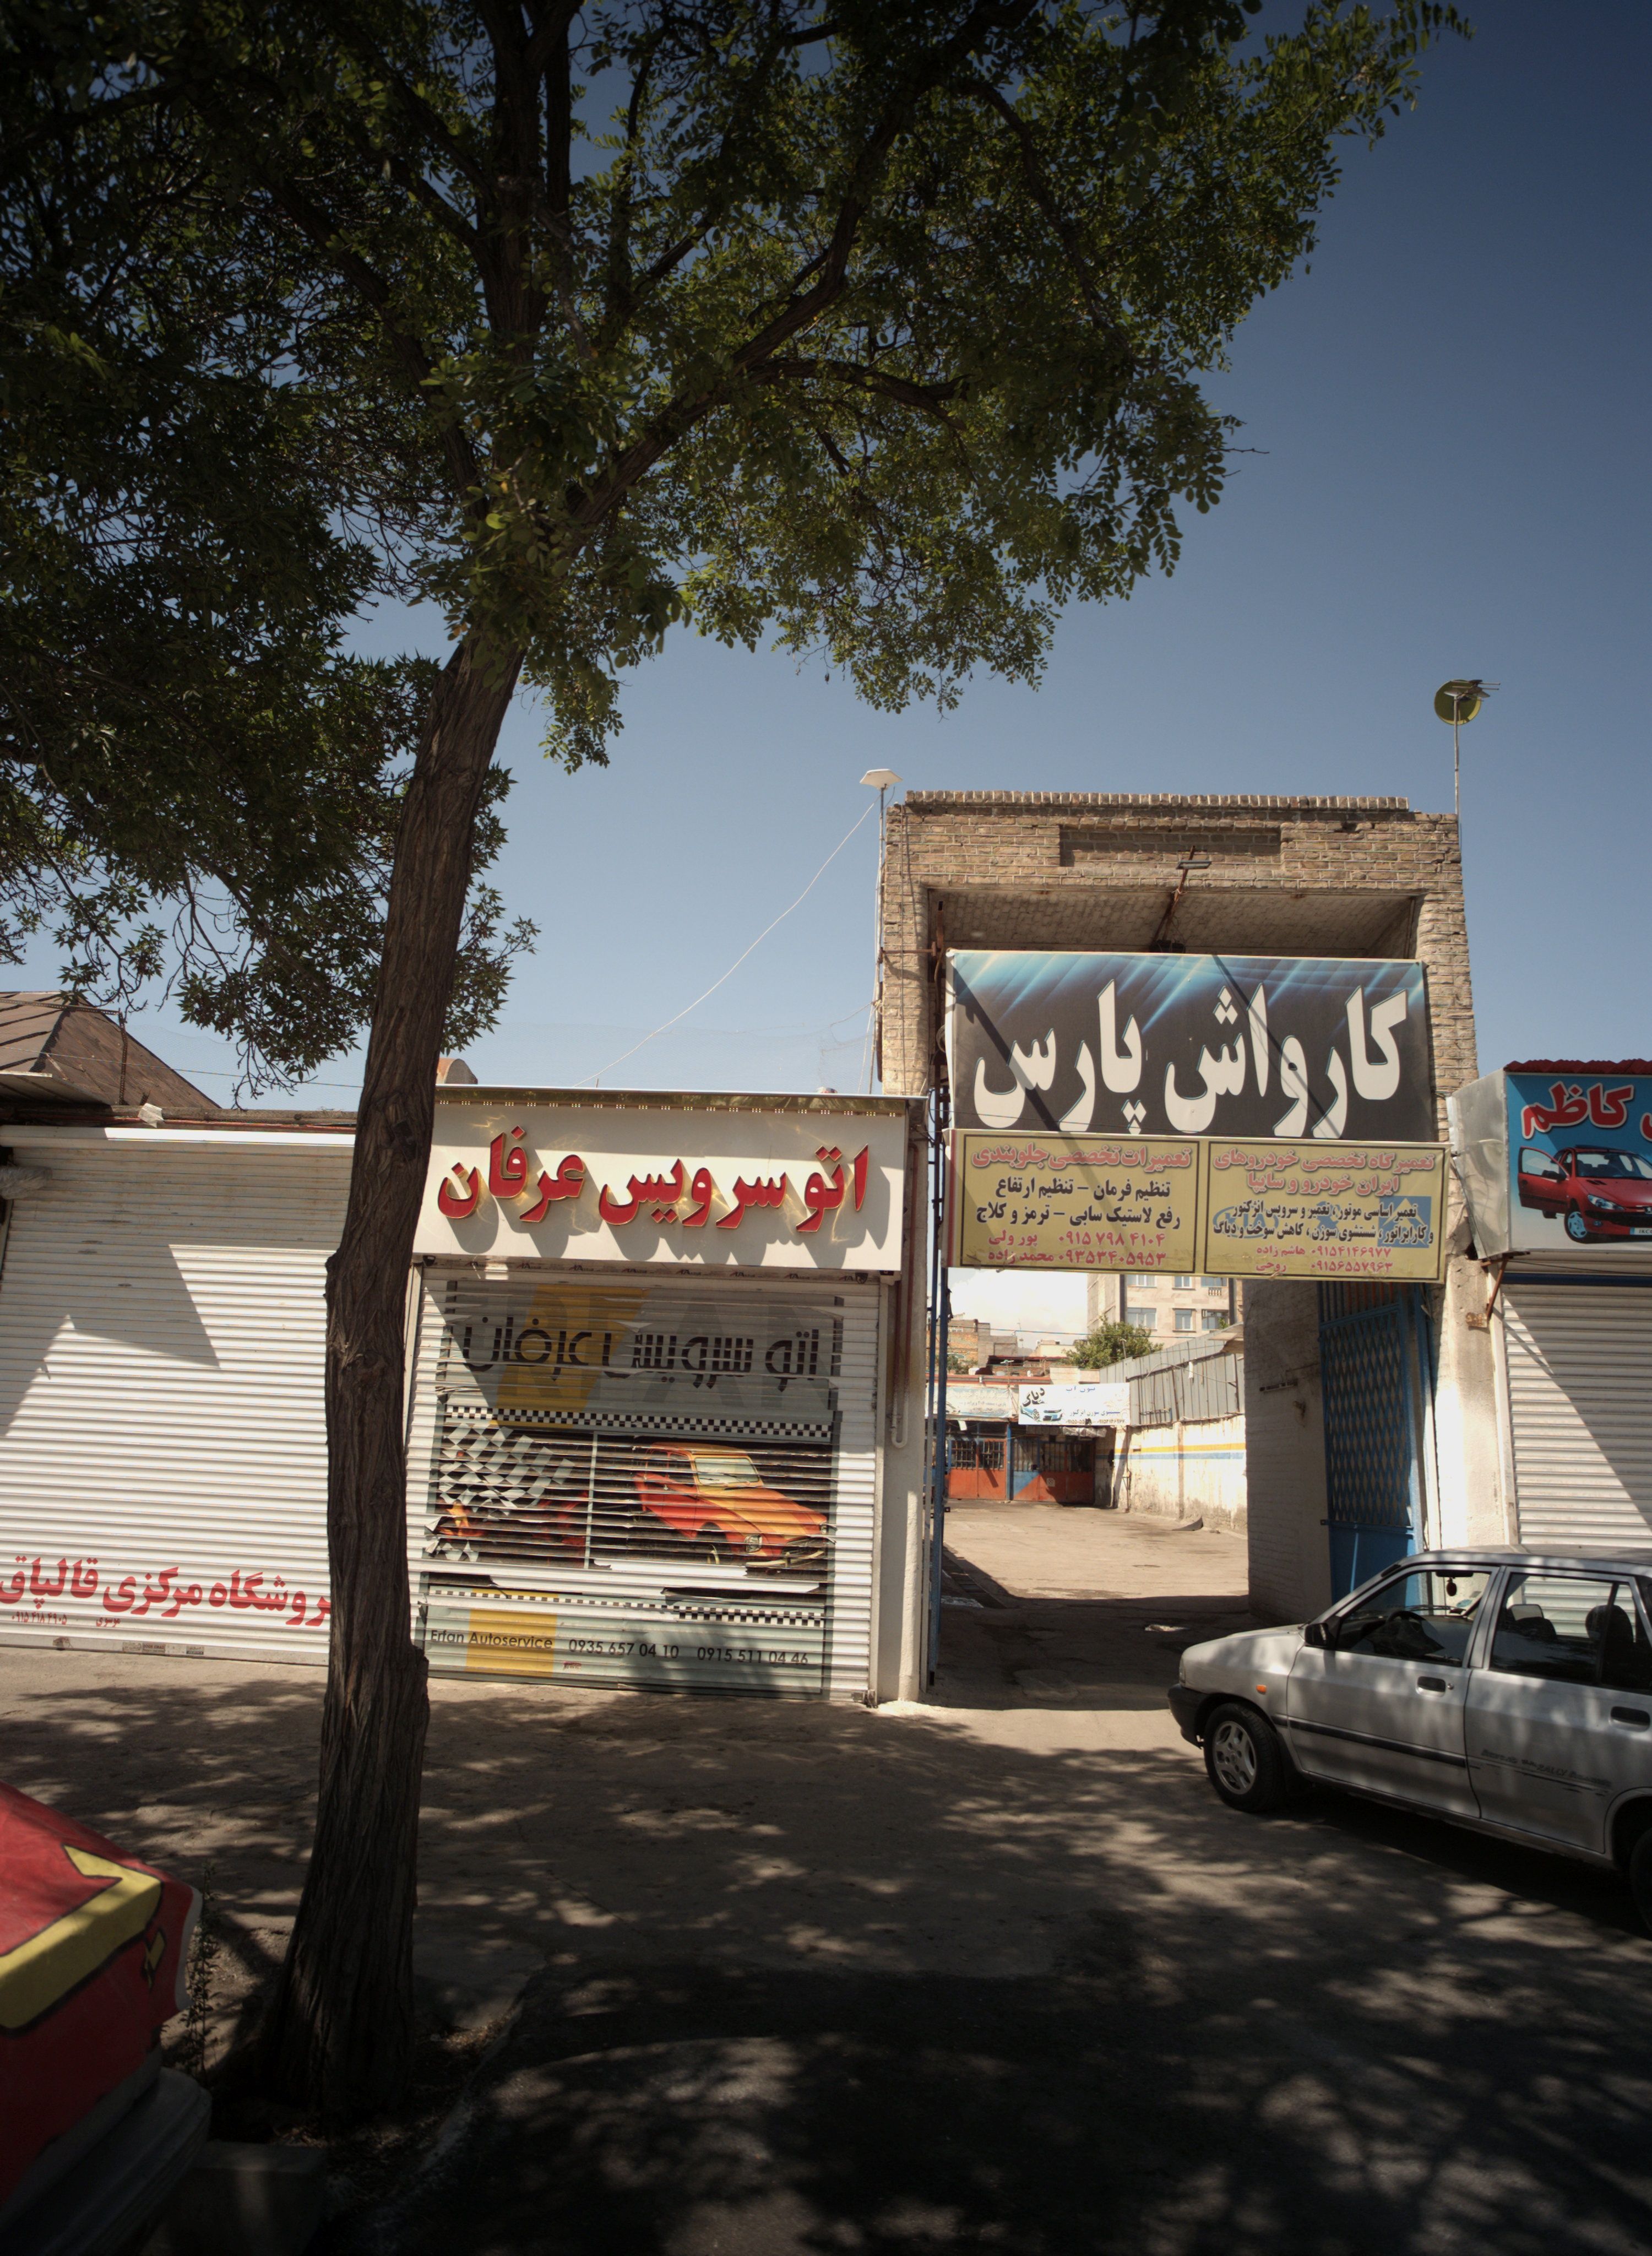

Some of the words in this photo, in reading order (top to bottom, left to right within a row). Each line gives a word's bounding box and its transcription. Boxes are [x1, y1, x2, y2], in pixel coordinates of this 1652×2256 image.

[974, 978, 1147, 1136] پارس
[1164, 982, 1409, 1140] کارواش
[1521, 1081, 1634, 1140] کاظم
[971, 1142, 1049, 1169] جلوبندی
[1048, 1145, 1121, 1170] تخصصی
[1121, 1146, 1192, 1173] تعمیرات
[1213, 1148, 1299, 1173] خودروهای
[1301, 1151, 1367, 1172] تخصصی
[438, 1125, 586, 1224] عرفان
[1247, 1171, 1285, 1195] سایپا
[1302, 1173, 1354, 1196] خودرو
[1356, 1174, 1400, 1197] ایران
[599, 1158, 787, 1229] سرویس
[795, 1144, 870, 1233] اتو
[995, 1176, 1036, 1198] ارتفاع
[1039, 1178, 1074, 1200] تنظیم
[1093, 1178, 1132, 1202] فرمان
[1135, 1180, 1171, 1202] تنظیم
[1287, 1179, 1298, 1194] و
[976, 1201, 1007, 1223] کلاج
[1010, 1211, 1018, 1224] و
[1021, 1204, 1050, 1225] ترمز
[1069, 1205, 1103, 1227] سابی
[1106, 1203, 1153, 1227] لاستیک
[1156, 1207, 1181, 1230] رفع
[1265, 1205, 1298, 1219] سرویس
[1300, 1208, 1306, 1219] و
[1307, 1202, 1330, 1219] تعمیر
[1364, 1203, 1393, 1221] اساسی
[1394, 1205, 1417, 1222] تعمیر
[988, 1229, 1016, 1246] ولی
[1018, 1234, 1039, 1248] پور
[1238, 1226, 1244, 1239] و
[1246, 1221, 1275, 1239] سوخت
[1277, 1222, 1304, 1239] کاهش
[1428, 1230, 1434, 1244] و
[988, 1248, 1016, 1265] زاده
[1019, 1249, 1055, 1262] محمد
[1256, 1244, 1279, 1257] زاده
[1280, 1245, 1306, 1256] هاشم
[1256, 1260, 1287, 1273] روحی
[463, 1316, 593, 1381] عرفان
[602, 1333, 754, 1389] سرویس
[765, 1328, 819, 1392] اتو
[0, 1555, 99, 1609] قالپاق
[102, 1566, 204, 1618] مرکزی
[208, 1569, 330, 1627] روشگاه
[96, 1616, 121, 1628] موسوی
[430, 1629, 465, 1644] Erfan
[469, 1631, 553, 1650] Autoservice
[568, 1639, 604, 1655] 0935
[607, 1641, 635, 1656] 657
[639, 1642, 657, 1658] 04
[662, 1644, 680, 1659] 10
[697, 1646, 734, 1663] 0915
[768, 1651, 787, 1666] 04
